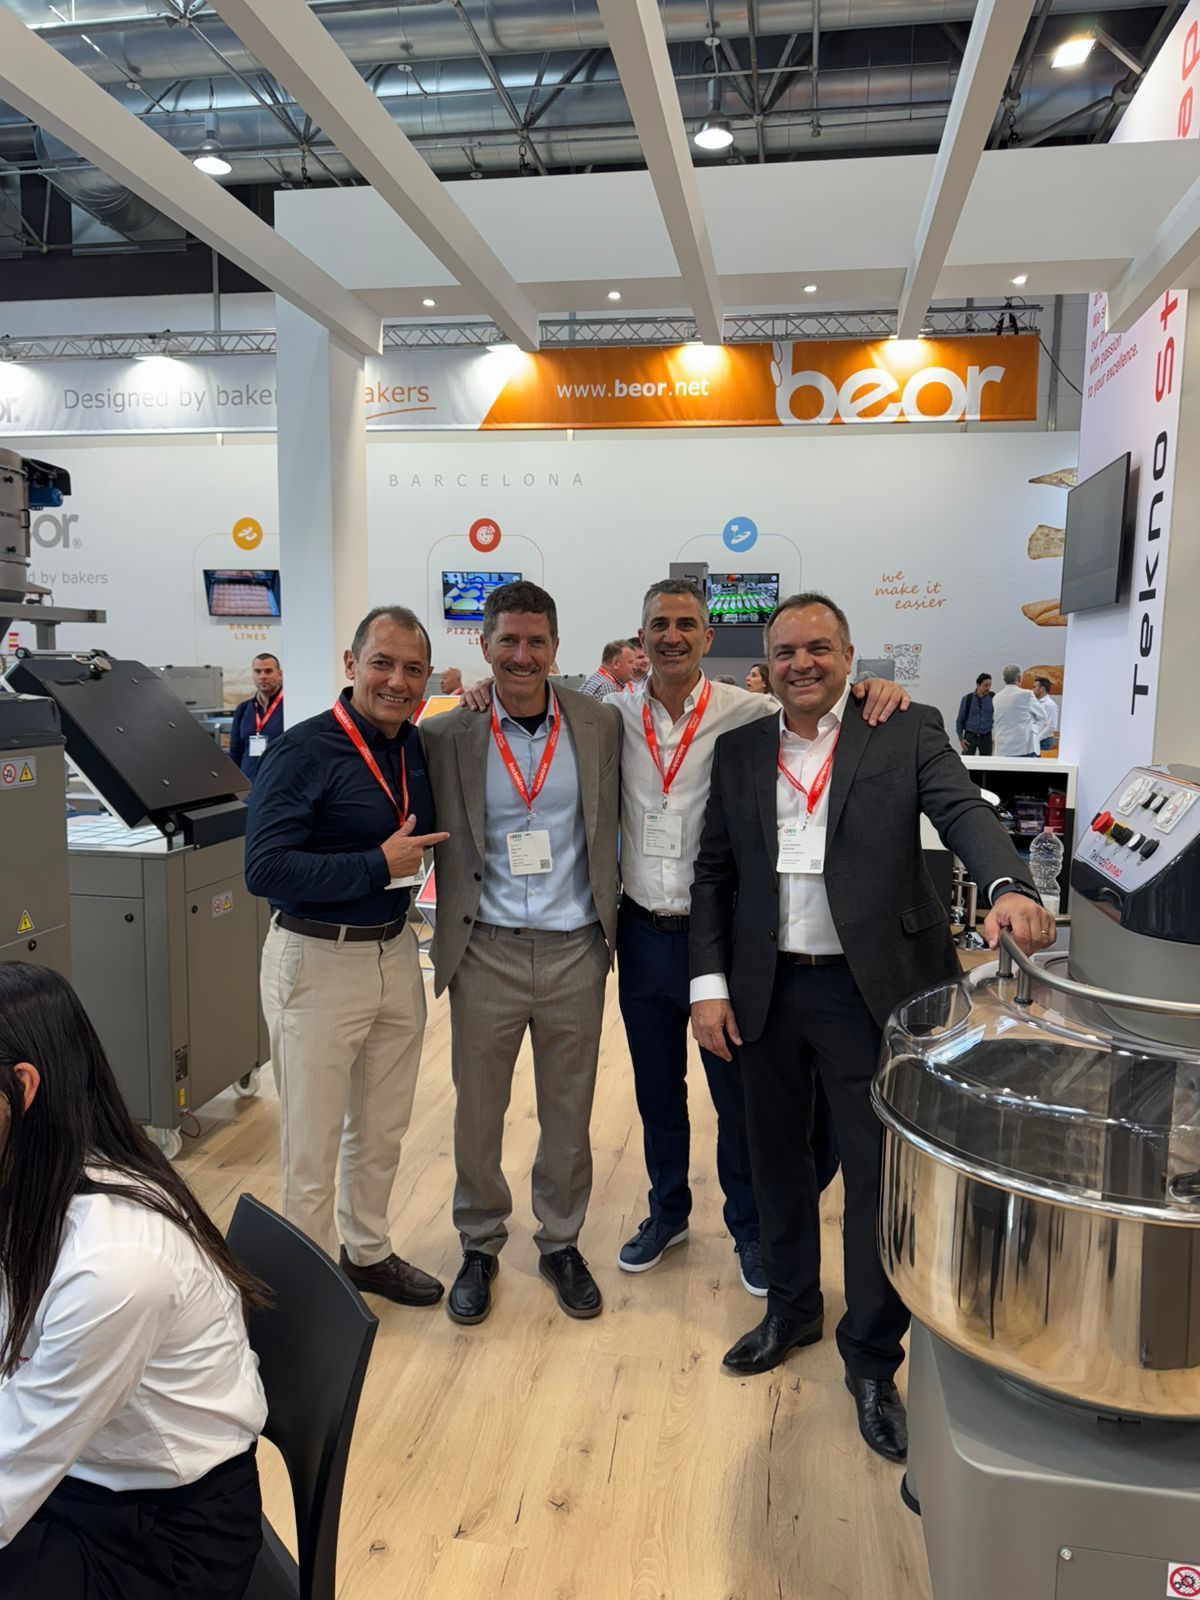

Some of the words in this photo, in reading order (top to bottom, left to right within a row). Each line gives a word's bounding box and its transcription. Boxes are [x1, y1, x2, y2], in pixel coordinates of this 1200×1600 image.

[1089, 356, 1101, 375] with
[1100, 335, 1122, 368] passion
[1093, 373, 1106, 399] your
[1105, 344, 1138, 382] excellence.
[365, 381, 430, 404] akers
[556, 378, 710, 398] www.beor.net
[769, 340, 1006, 425] beor
[64, 388, 169, 413] Designed
[179, 386, 207, 411] by
[216, 384, 277, 407] bake
[389, 473, 584, 488] BARCELONA
[41, 571, 58, 586] by
[62, 571, 109, 585] bakers
[882, 570, 905, 583] we
[1131, 430, 1168, 715] Tekno
[875, 582, 920, 596] make
[926, 580, 942, 594] it
[895, 595, 947, 610] easier
[446, 627, 480, 635] PIZZA
